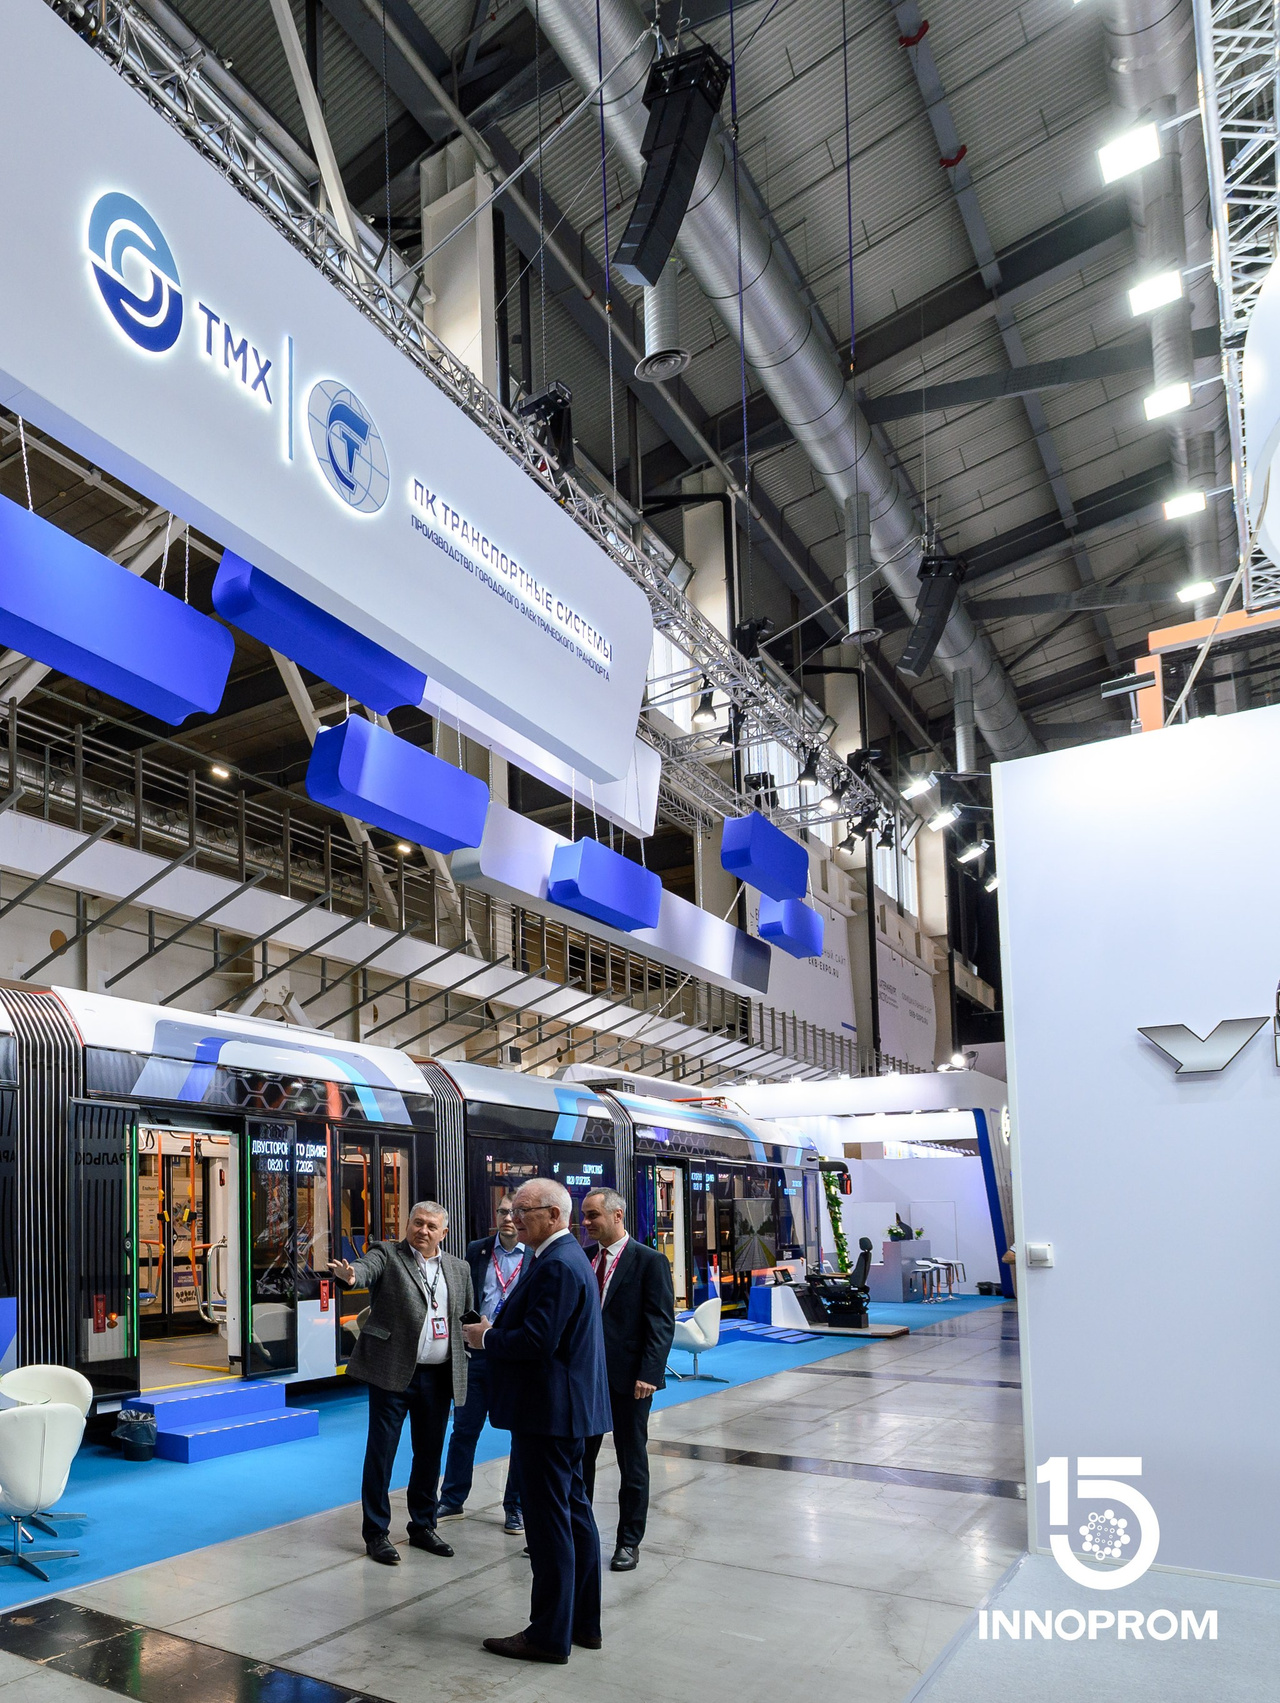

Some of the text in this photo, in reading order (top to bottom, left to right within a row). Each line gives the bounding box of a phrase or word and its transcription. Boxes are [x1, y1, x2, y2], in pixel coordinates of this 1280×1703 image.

[197, 302, 273, 404] ТМХ
[411, 514, 610, 682] ПРОИЗВОДСТВО ГОРОДСКОГО ЭЛЕКТРИЧЕСКОГО ТРАНСПОРТА
[413, 478, 613, 661] ПК ТРАНСПОРТНЫЕ СИСТЕМЫ
